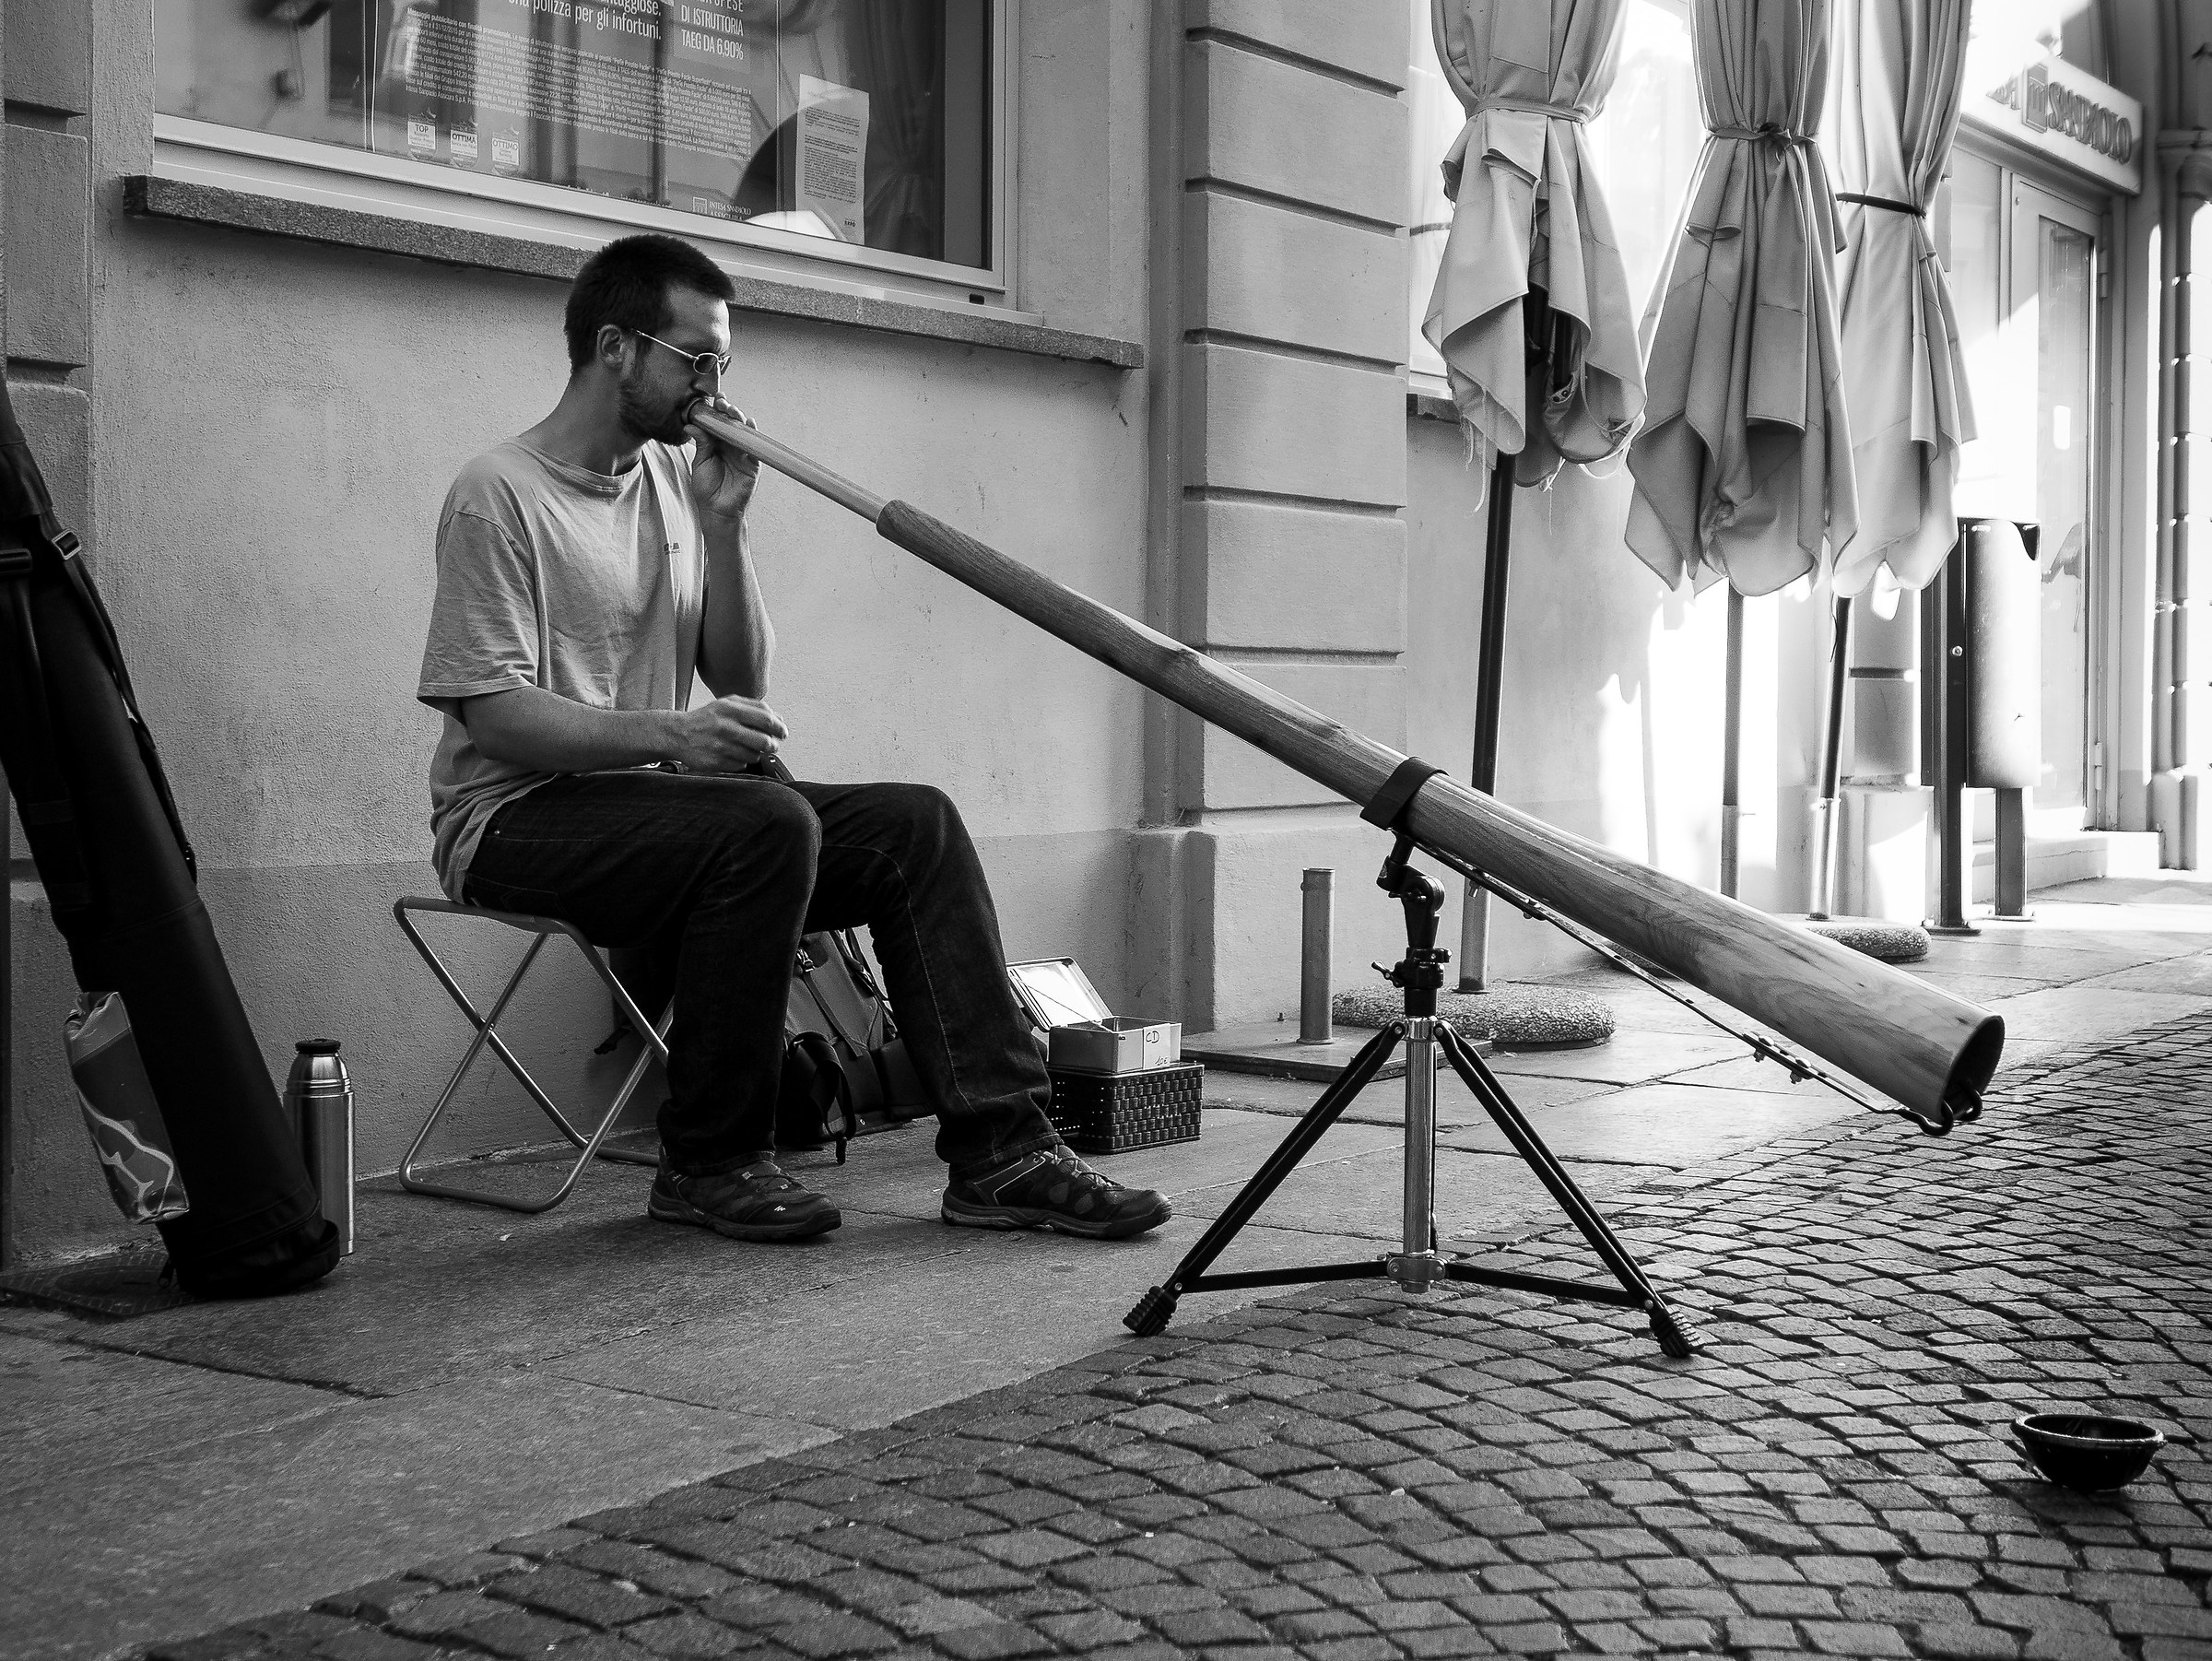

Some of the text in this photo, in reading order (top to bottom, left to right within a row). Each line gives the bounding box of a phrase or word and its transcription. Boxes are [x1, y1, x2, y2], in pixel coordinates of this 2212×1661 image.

[533, 0, 662, 40] polizza per gli infortuni.
[681, 5, 744, 36] DI ISTRUTTORIA
[681, 29, 744, 60] TAEG DA 6,90%
[416, 124, 429, 133] TOP
[1146, 1030, 1160, 1043] CD
